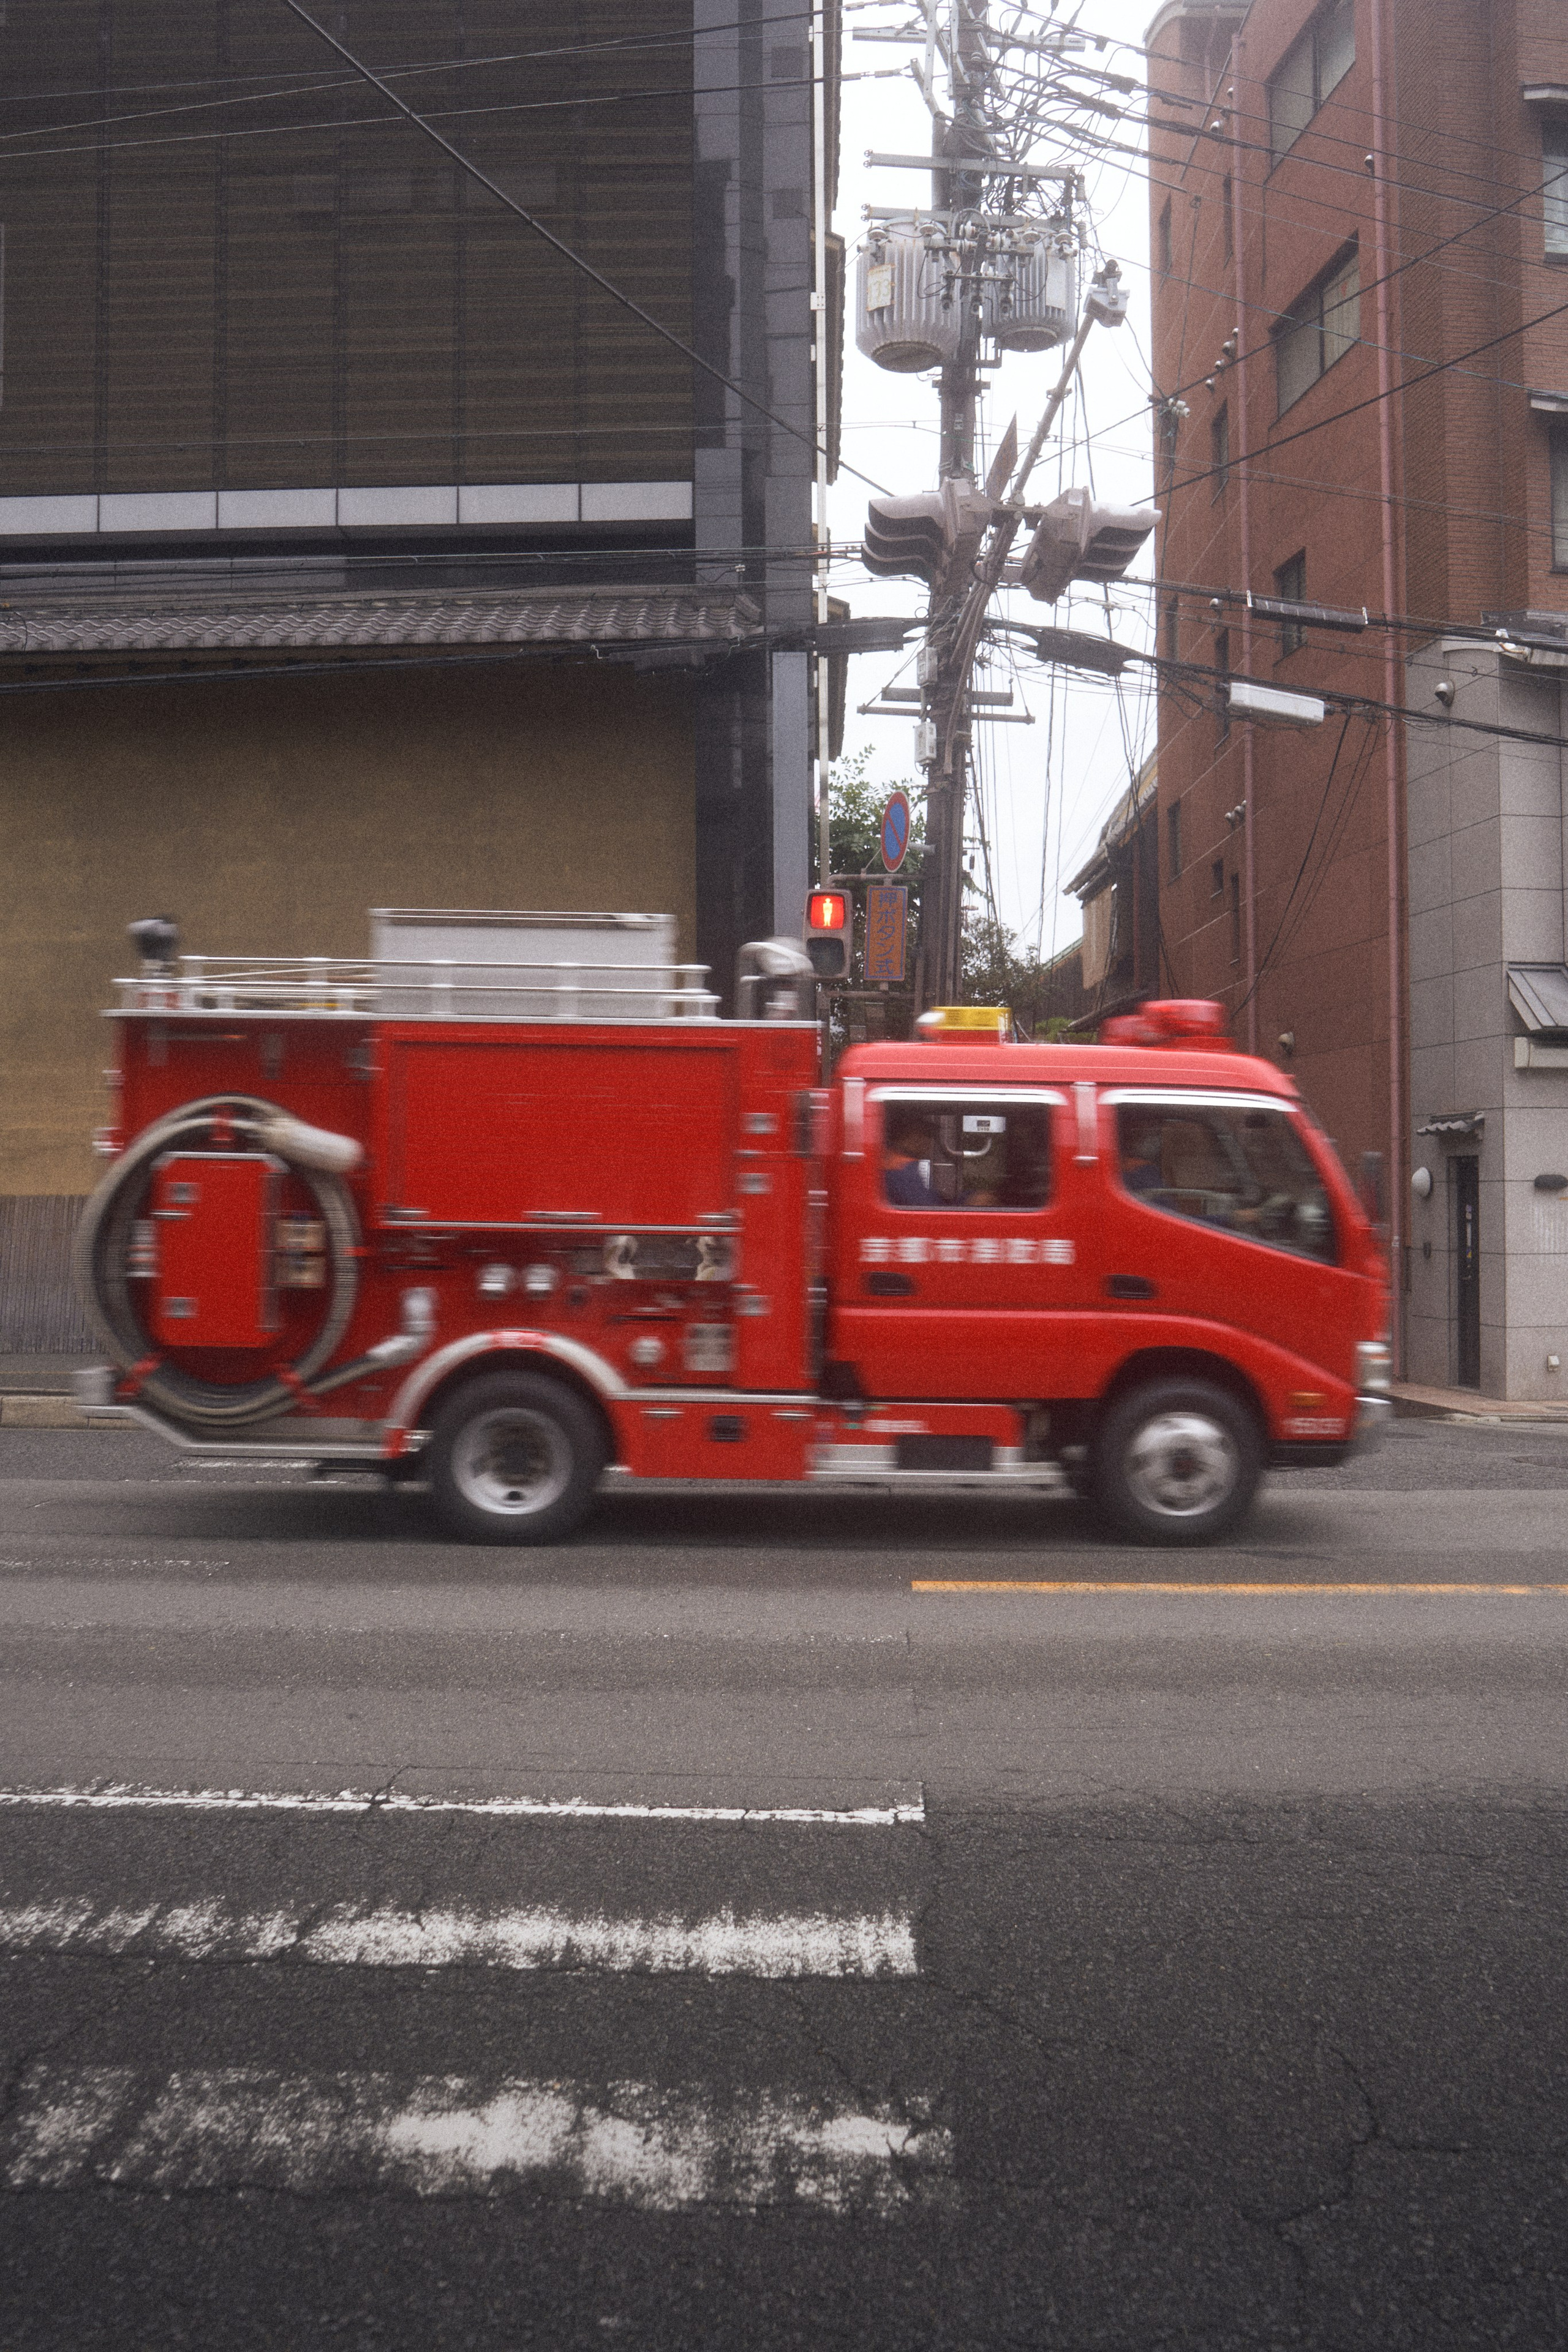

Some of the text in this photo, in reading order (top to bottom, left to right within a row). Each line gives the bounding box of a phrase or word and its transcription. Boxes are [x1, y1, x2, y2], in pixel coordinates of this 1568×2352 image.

[875, 892, 898, 975] 押ボタン式
